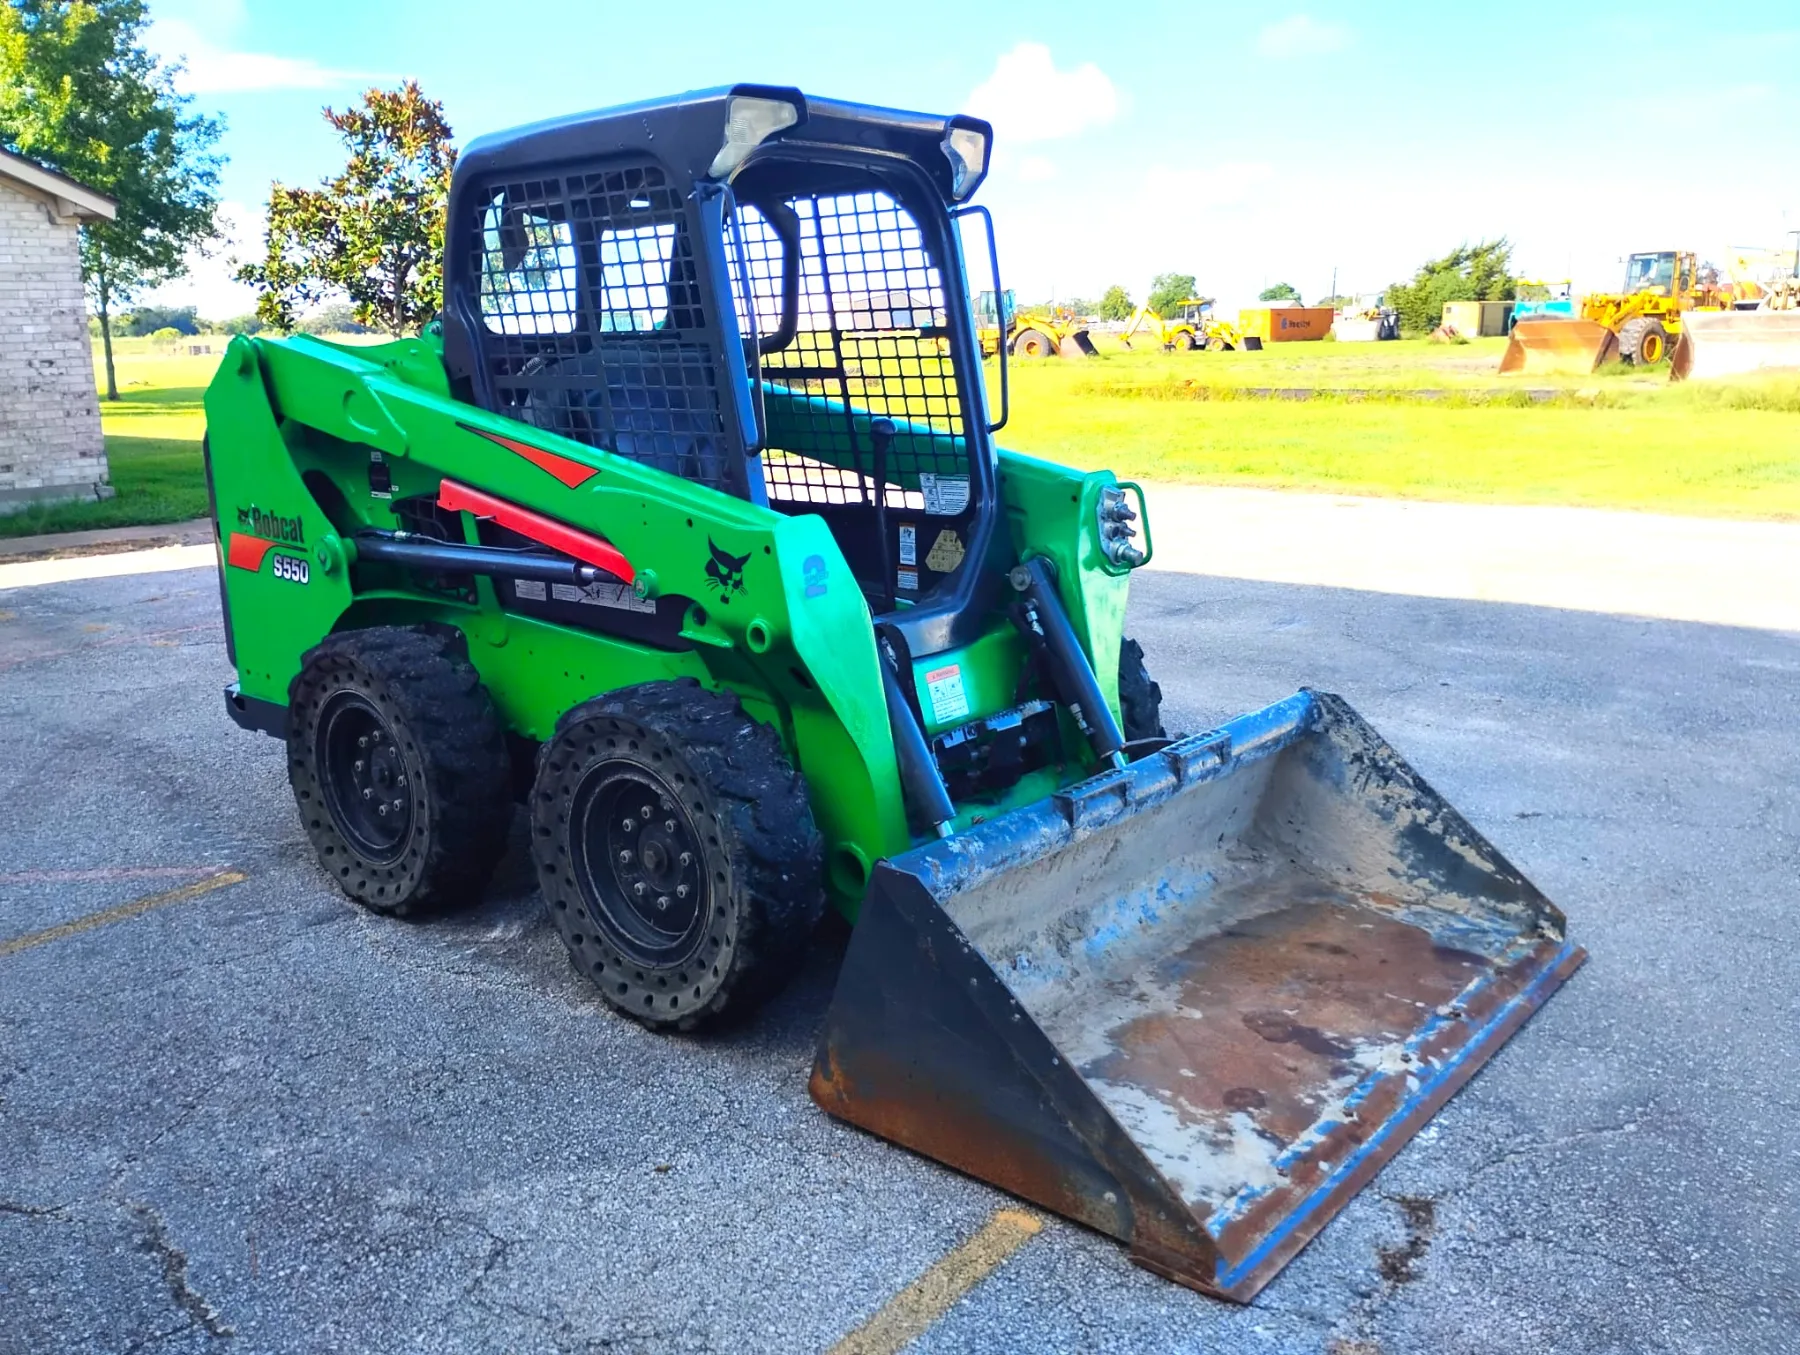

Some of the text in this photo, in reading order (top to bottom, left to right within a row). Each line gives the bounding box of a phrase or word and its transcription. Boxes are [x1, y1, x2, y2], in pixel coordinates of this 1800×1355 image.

[252, 507, 305, 543] Bobcat
[273, 553, 309, 585] S550
[803, 554, 827, 598] 2
